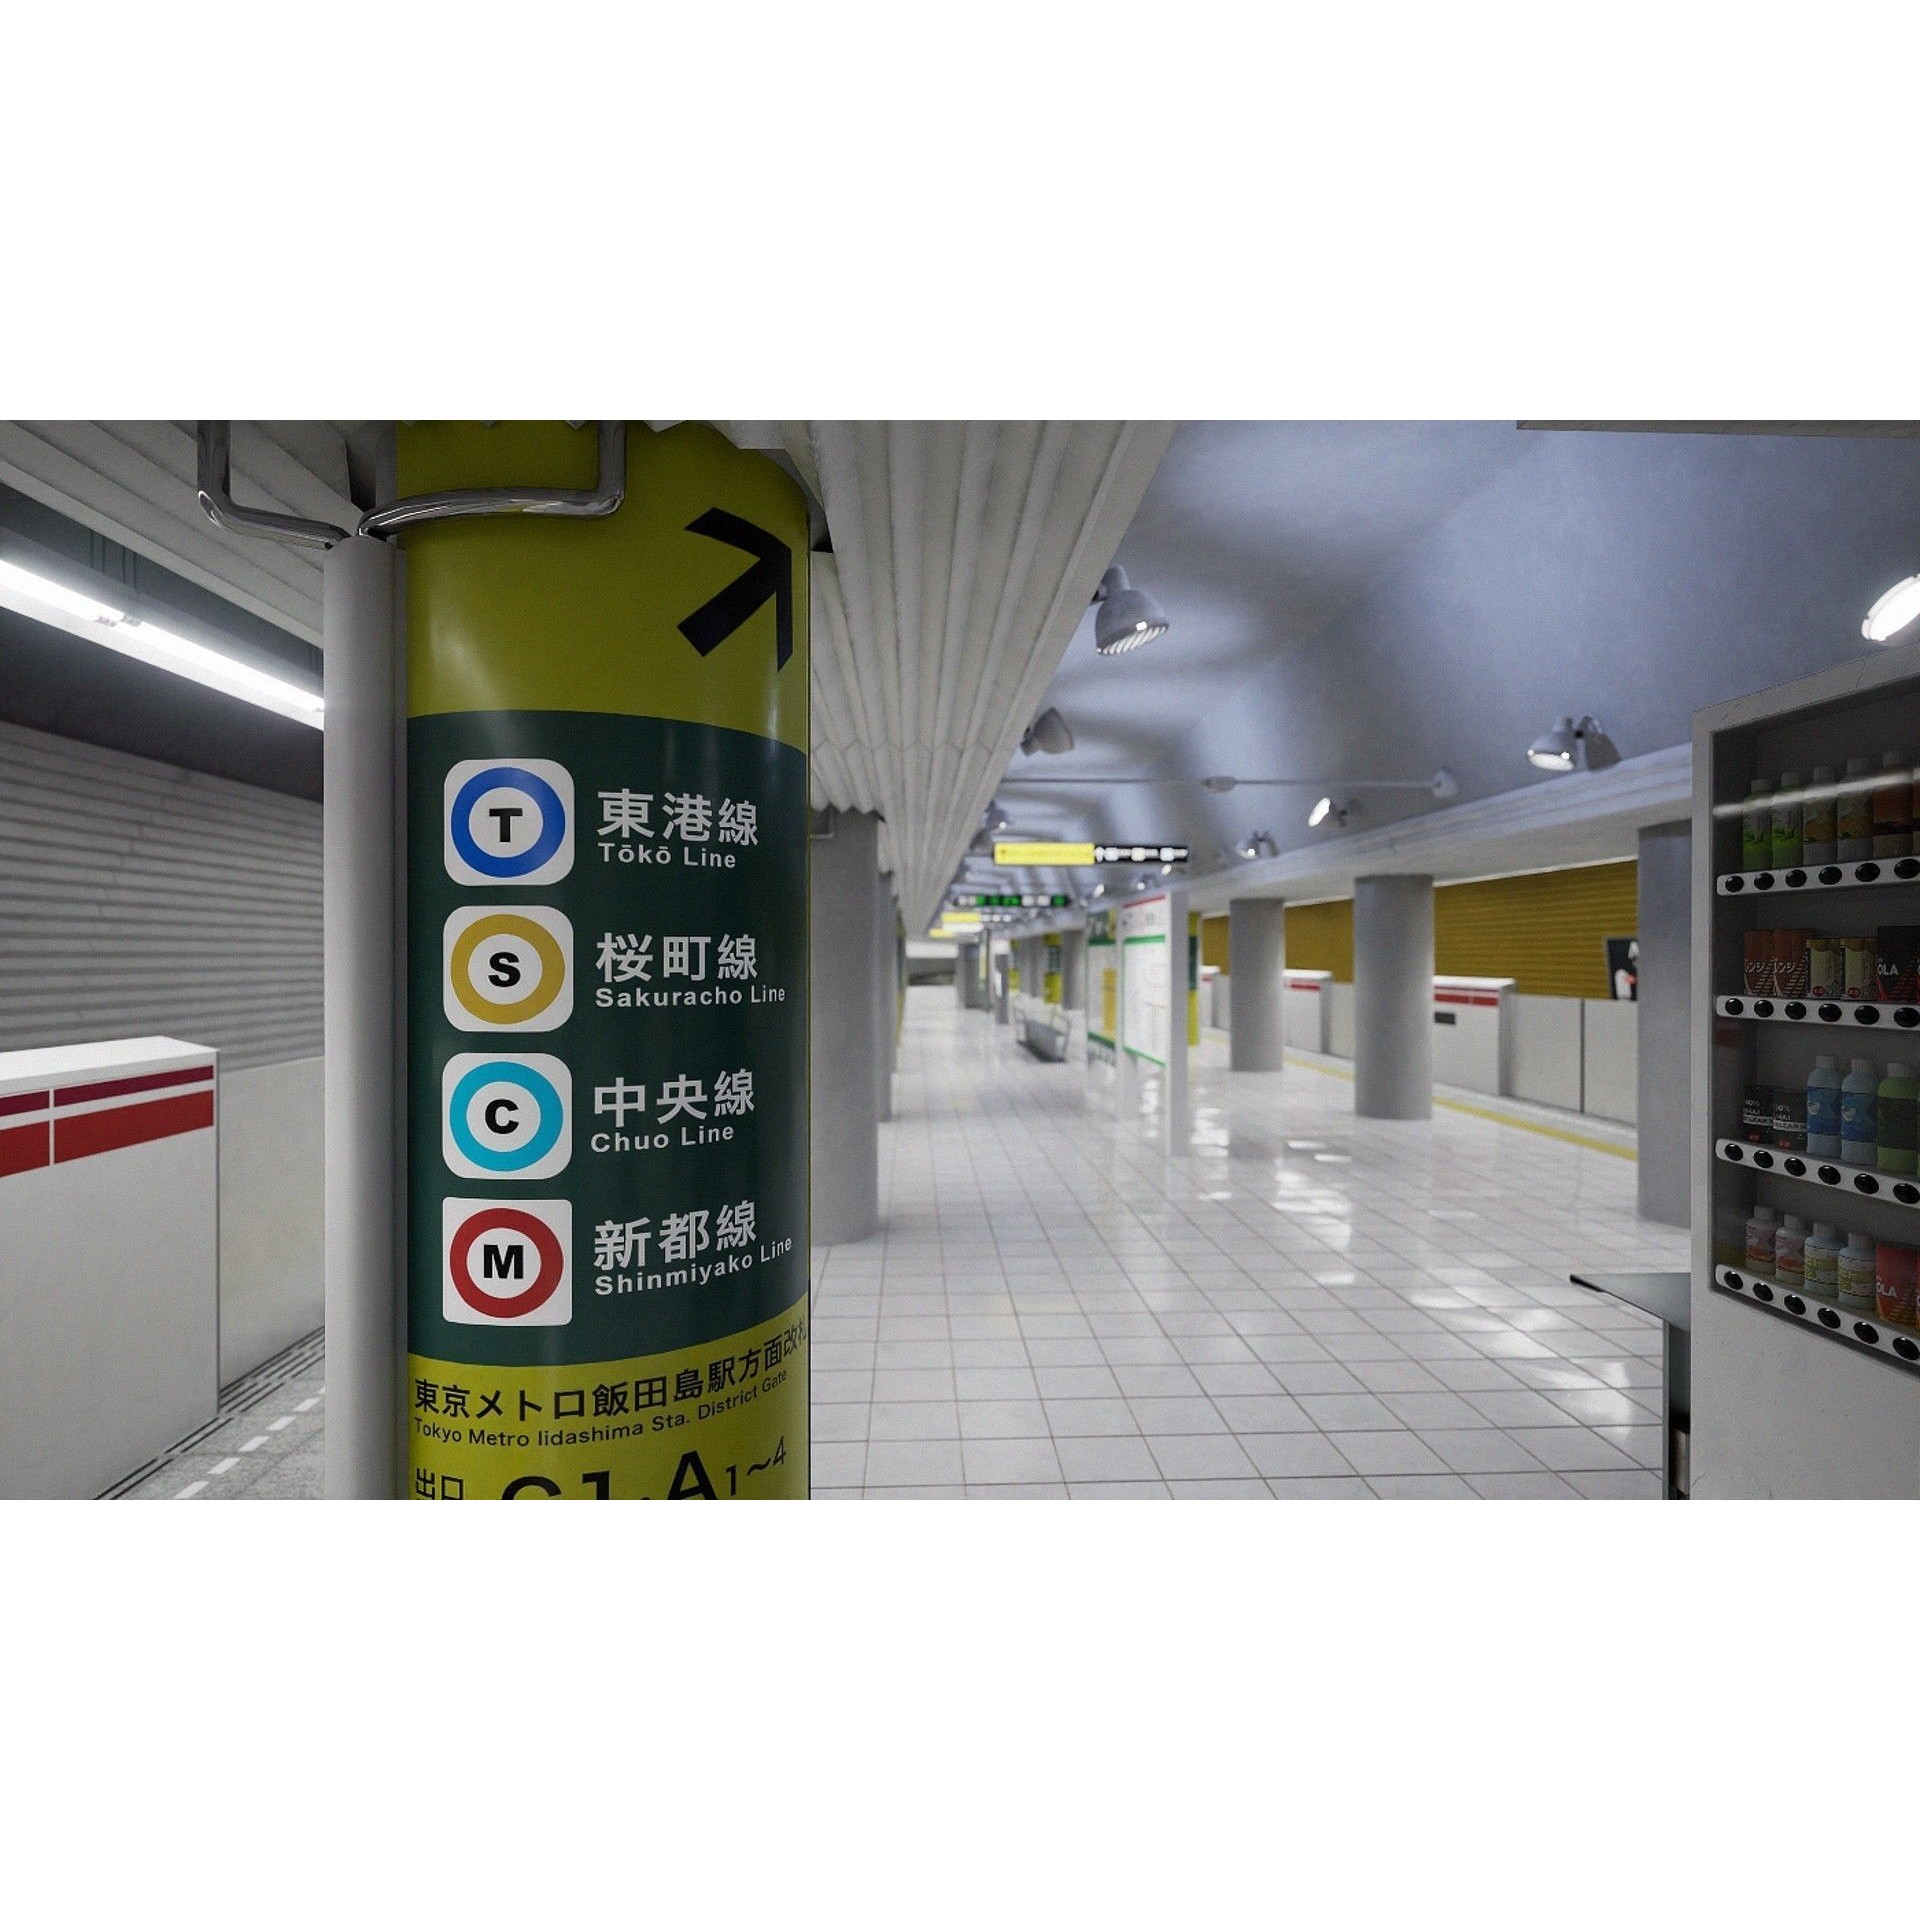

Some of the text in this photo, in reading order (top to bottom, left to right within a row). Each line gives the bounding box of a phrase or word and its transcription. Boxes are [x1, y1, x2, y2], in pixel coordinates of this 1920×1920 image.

[489, 807, 523, 843] T
[597, 788, 759, 846] 東港線
[598, 842, 736, 869] Tōkō Line
[488, 951, 521, 988] S
[595, 932, 758, 983] 桜町線
[595, 985, 786, 1008] Sakuracho Line
[484, 1098, 519, 1135] C
[593, 1068, 756, 1128] 中央線
[591, 1124, 735, 1153] Chuo Line
[594, 1200, 757, 1271] 新都線
[483, 1243, 524, 1280] M
[595, 1236, 792, 1297] Shinmiyako Line
[414, 1369, 787, 1447] Tokyo Metro Iidashima Sta. District Gate
[416, 1467, 464, 1500] 出口
